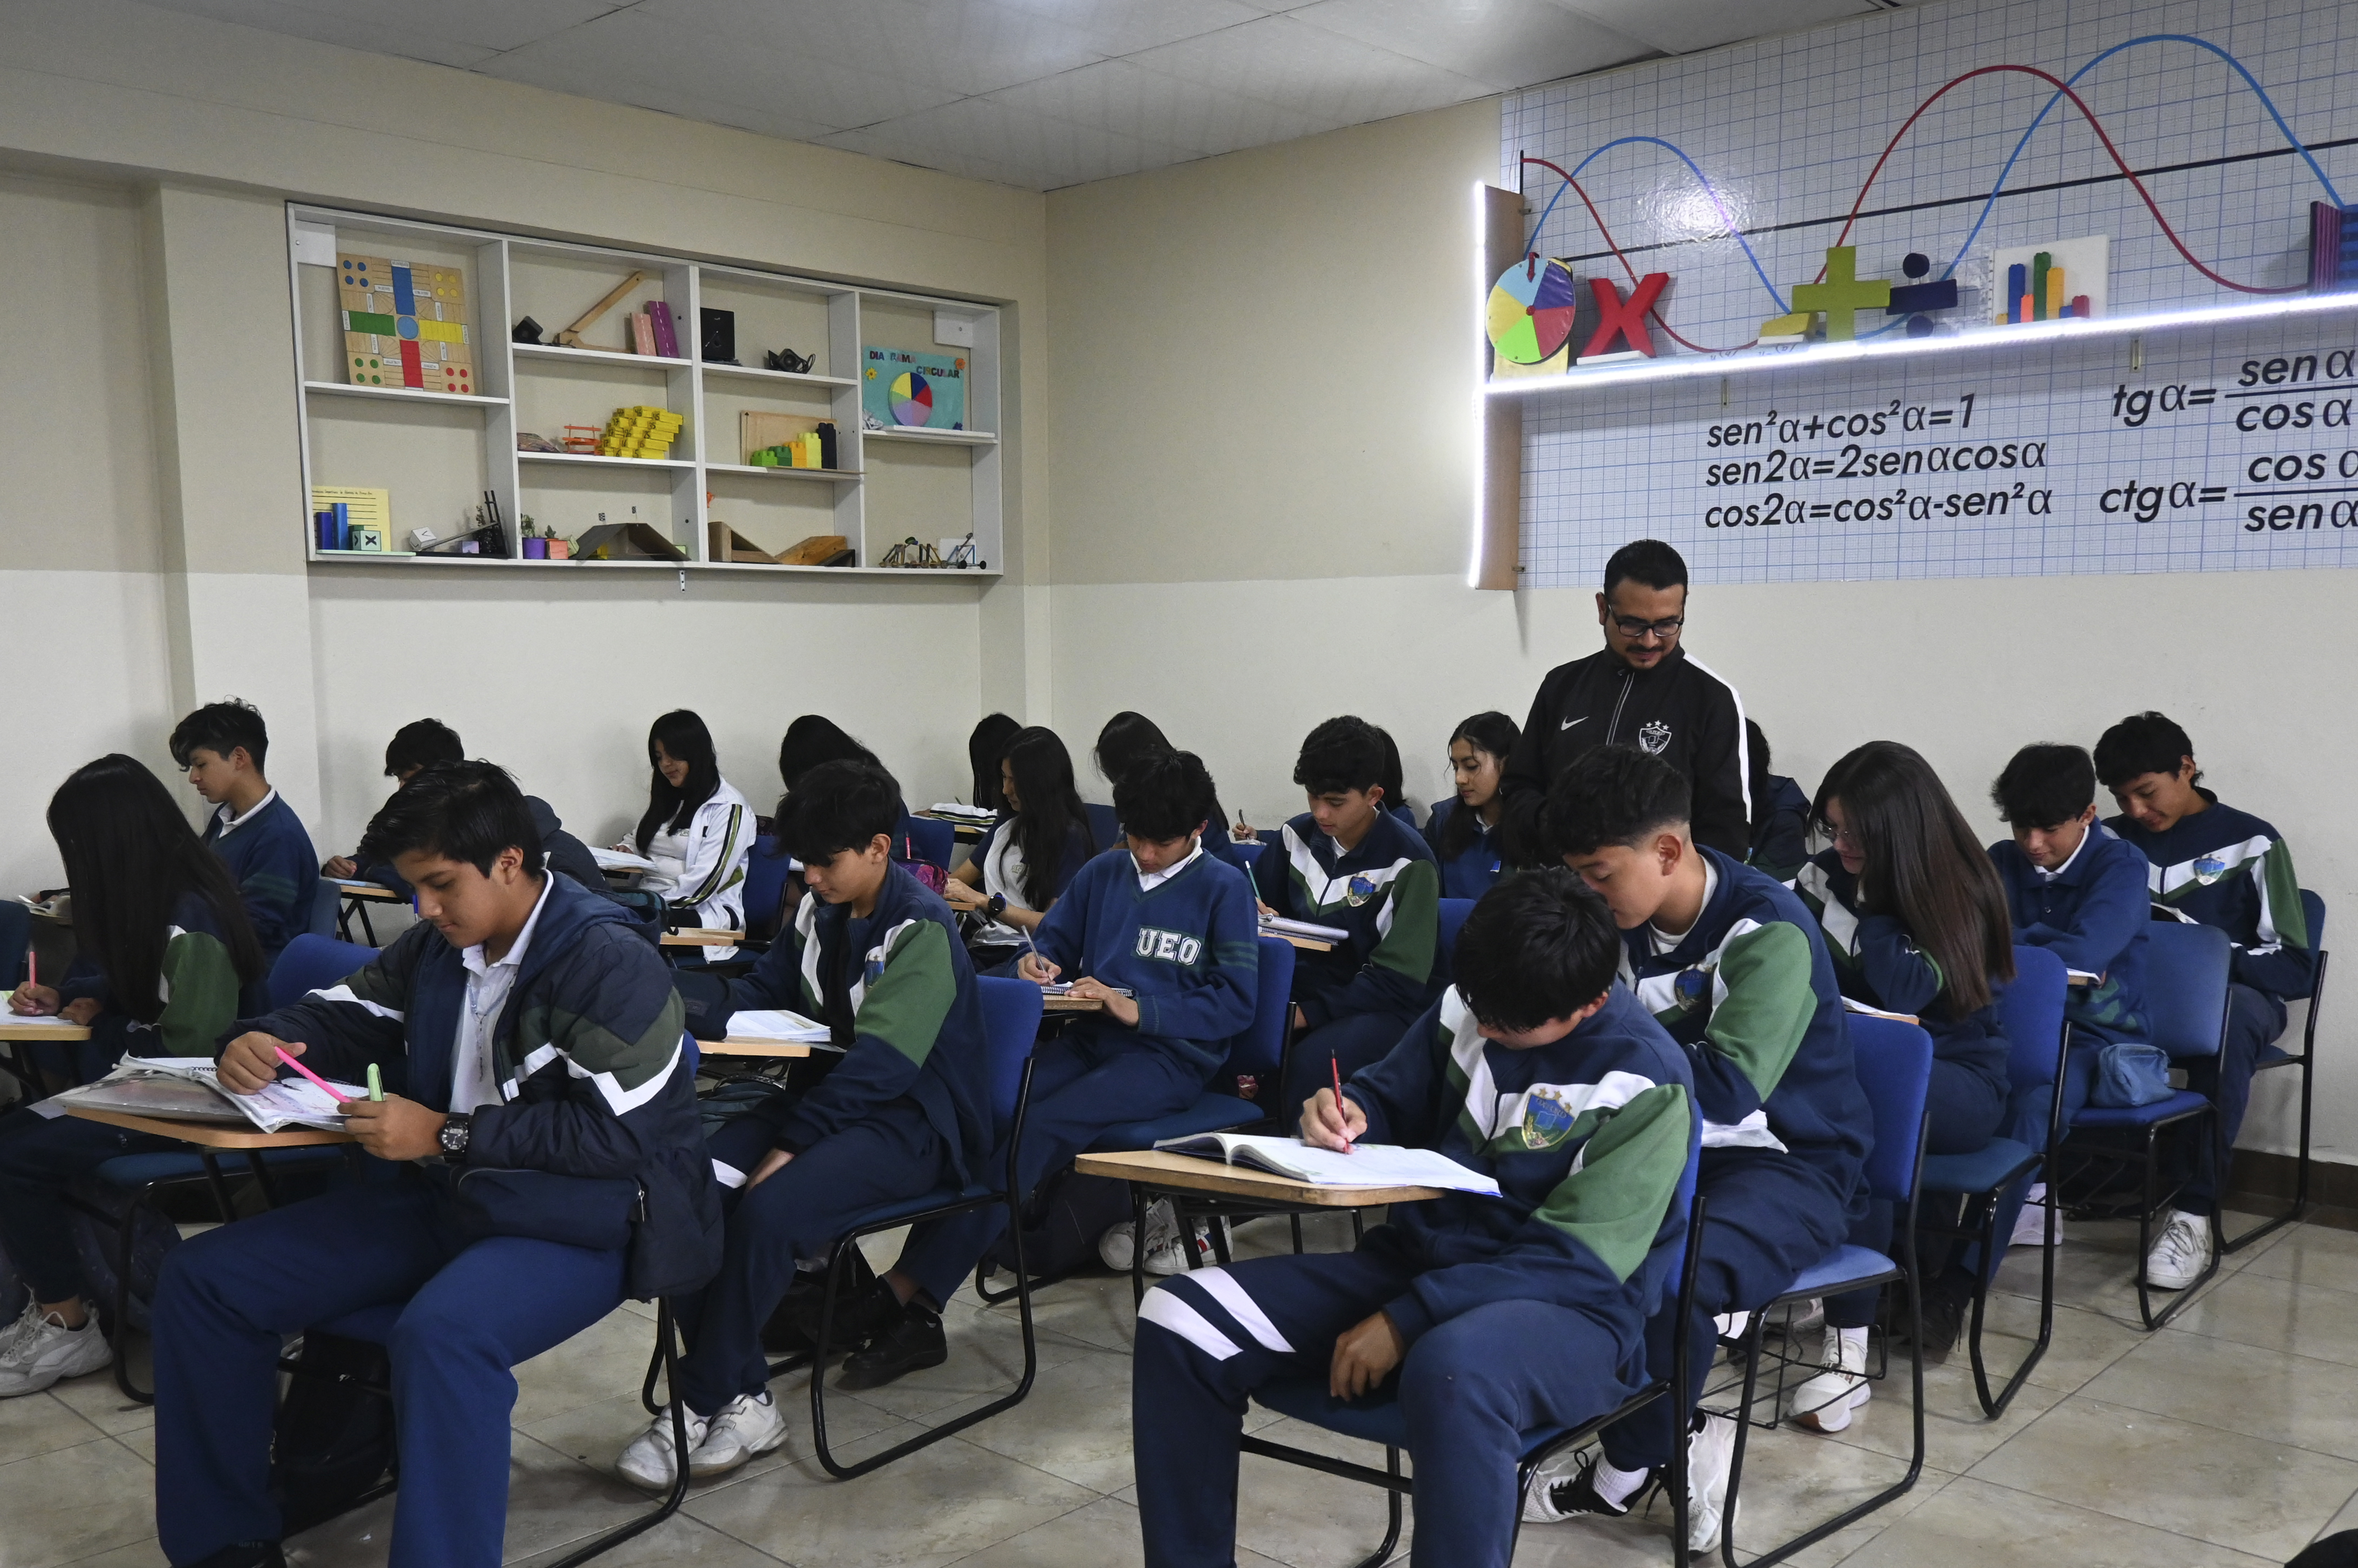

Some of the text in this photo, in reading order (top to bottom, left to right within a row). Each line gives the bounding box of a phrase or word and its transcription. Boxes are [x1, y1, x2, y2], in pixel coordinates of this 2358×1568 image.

[916, 366, 960, 378] CIRCULAR
[2237, 355, 2318, 387] sen
[2236, 402, 2315, 432] cos
[2248, 453, 2326, 482] cos
[2244, 503, 2323, 532] sen
[1136, 928, 1202, 966] UEO
[1536, 1098, 1567, 1119] OXFORD
